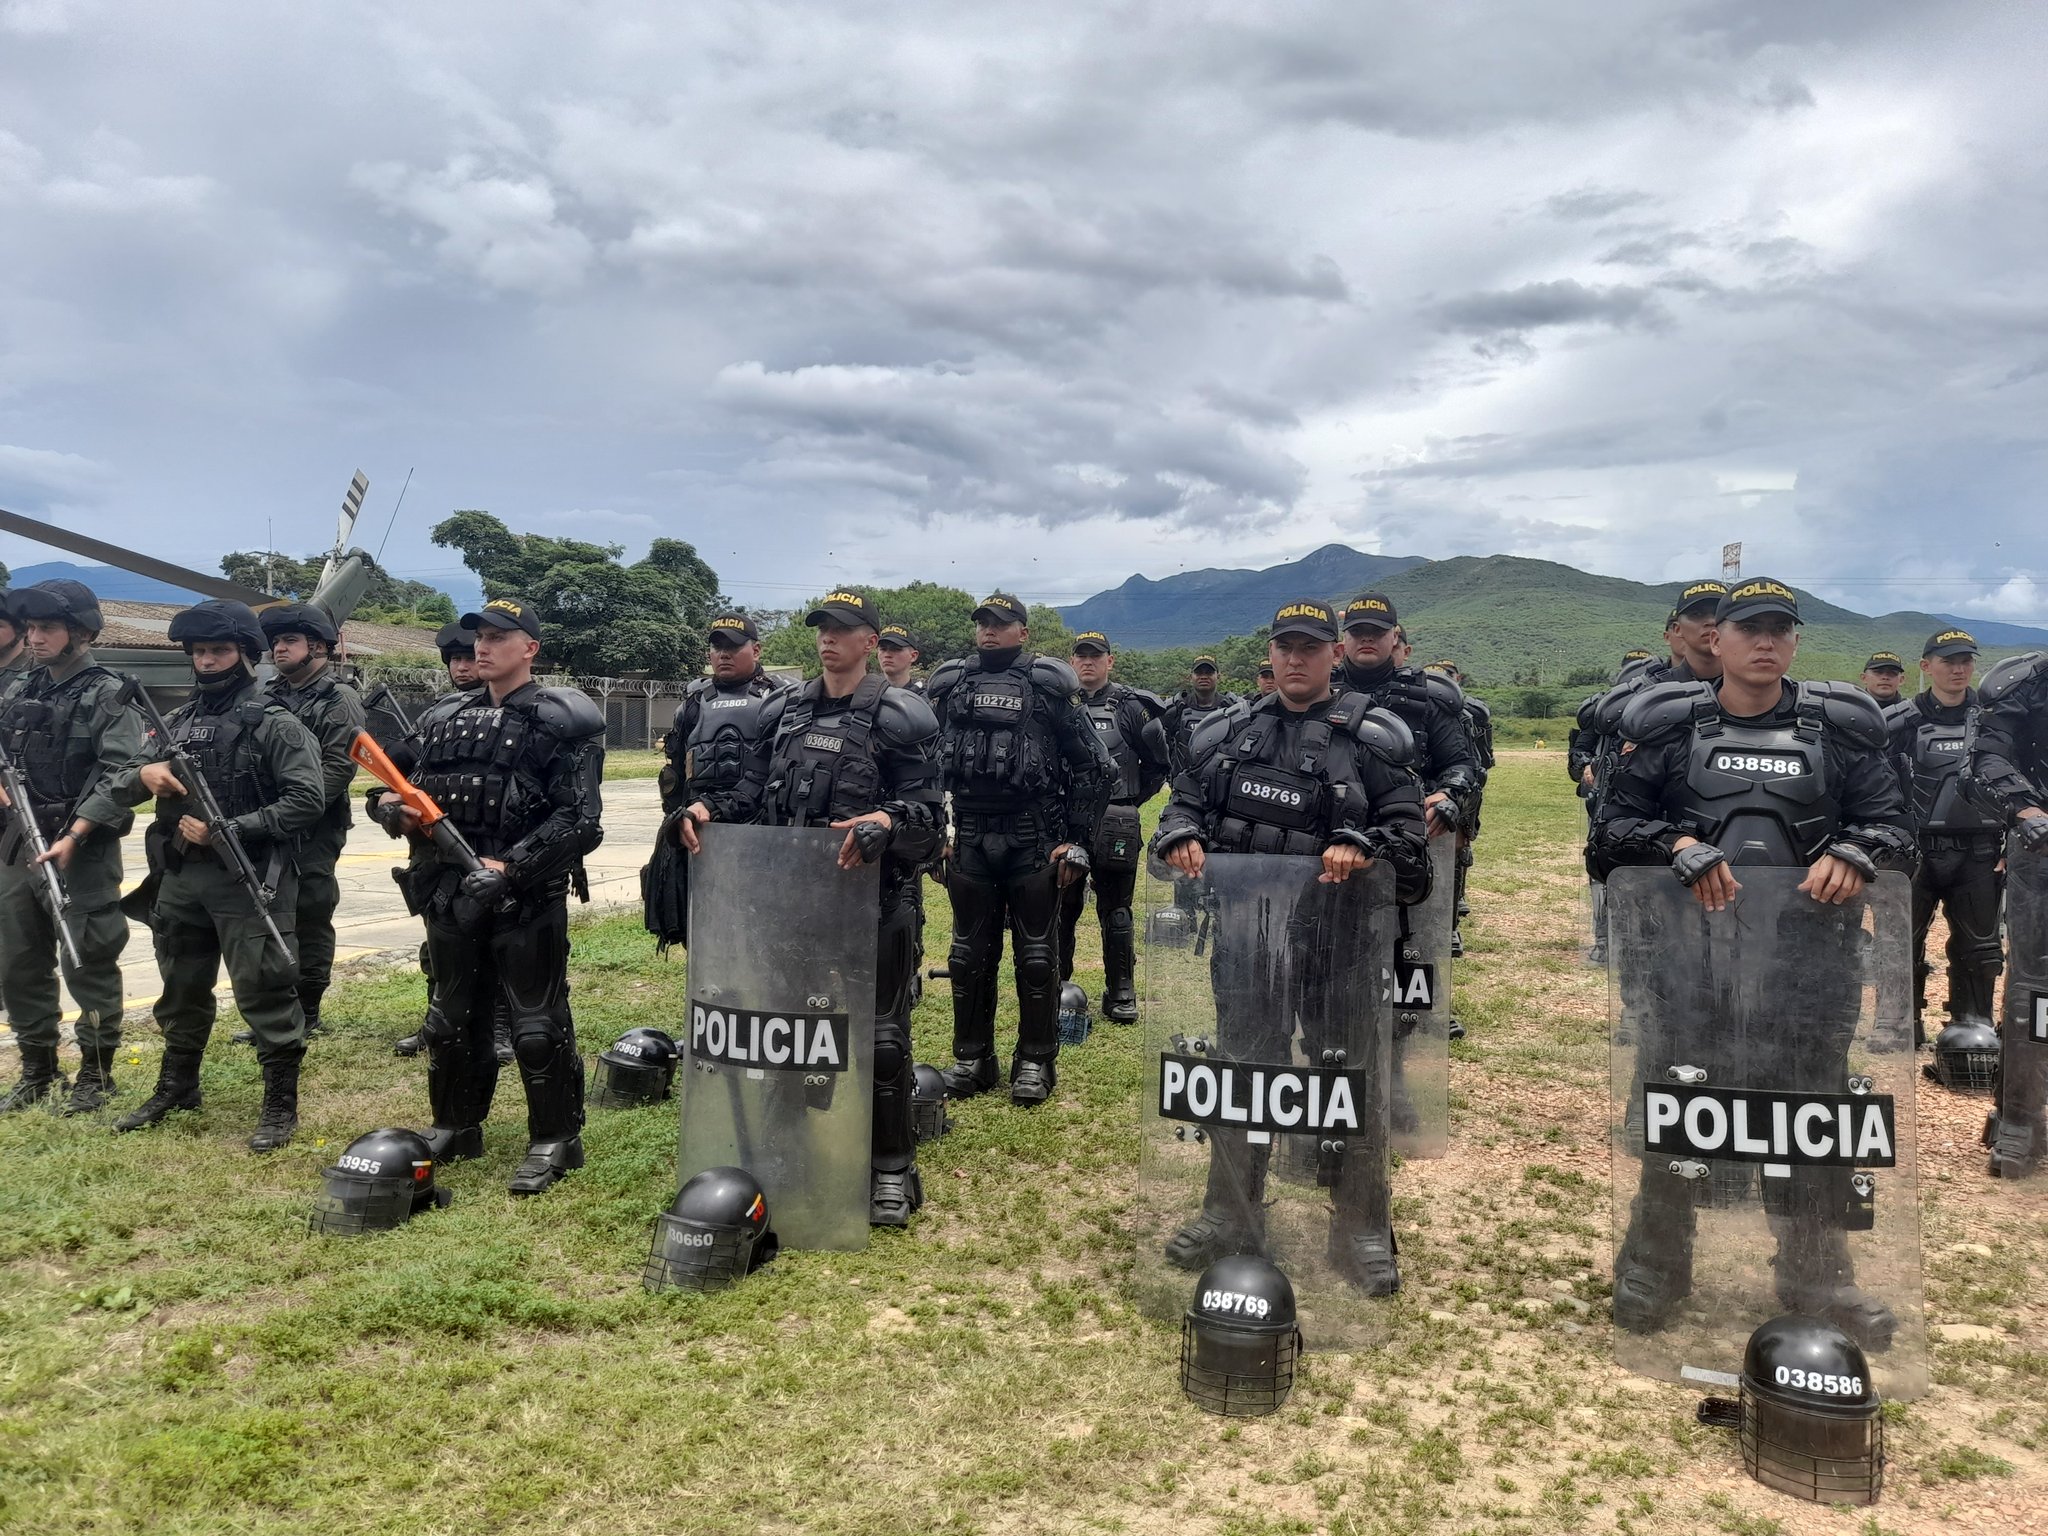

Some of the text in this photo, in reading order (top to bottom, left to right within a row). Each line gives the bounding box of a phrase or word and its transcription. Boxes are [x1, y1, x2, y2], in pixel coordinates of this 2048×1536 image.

[1732, 582, 1796, 604] POLICIA
[1277, 604, 1328, 622] POLICIA
[1347, 600, 1388, 613] POLICIA
[711, 618, 745, 630] POLICIA
[1936, 632, 1974, 643] POLICIA
[711, 699, 748, 709] 173803
[975, 695, 1021, 708] 102725
[807, 735, 841, 750] 030660
[1717, 756, 1801, 776] 038586
[1241, 781, 1301, 806] 038769
[693, 1005, 840, 1065] POLICIA
[1163, 1060, 1359, 1129] POLICIA
[1647, 1091, 1893, 1158] POLICIA
[1203, 1291, 1268, 1317] 038769
[1775, 1366, 1863, 1395] 038586
